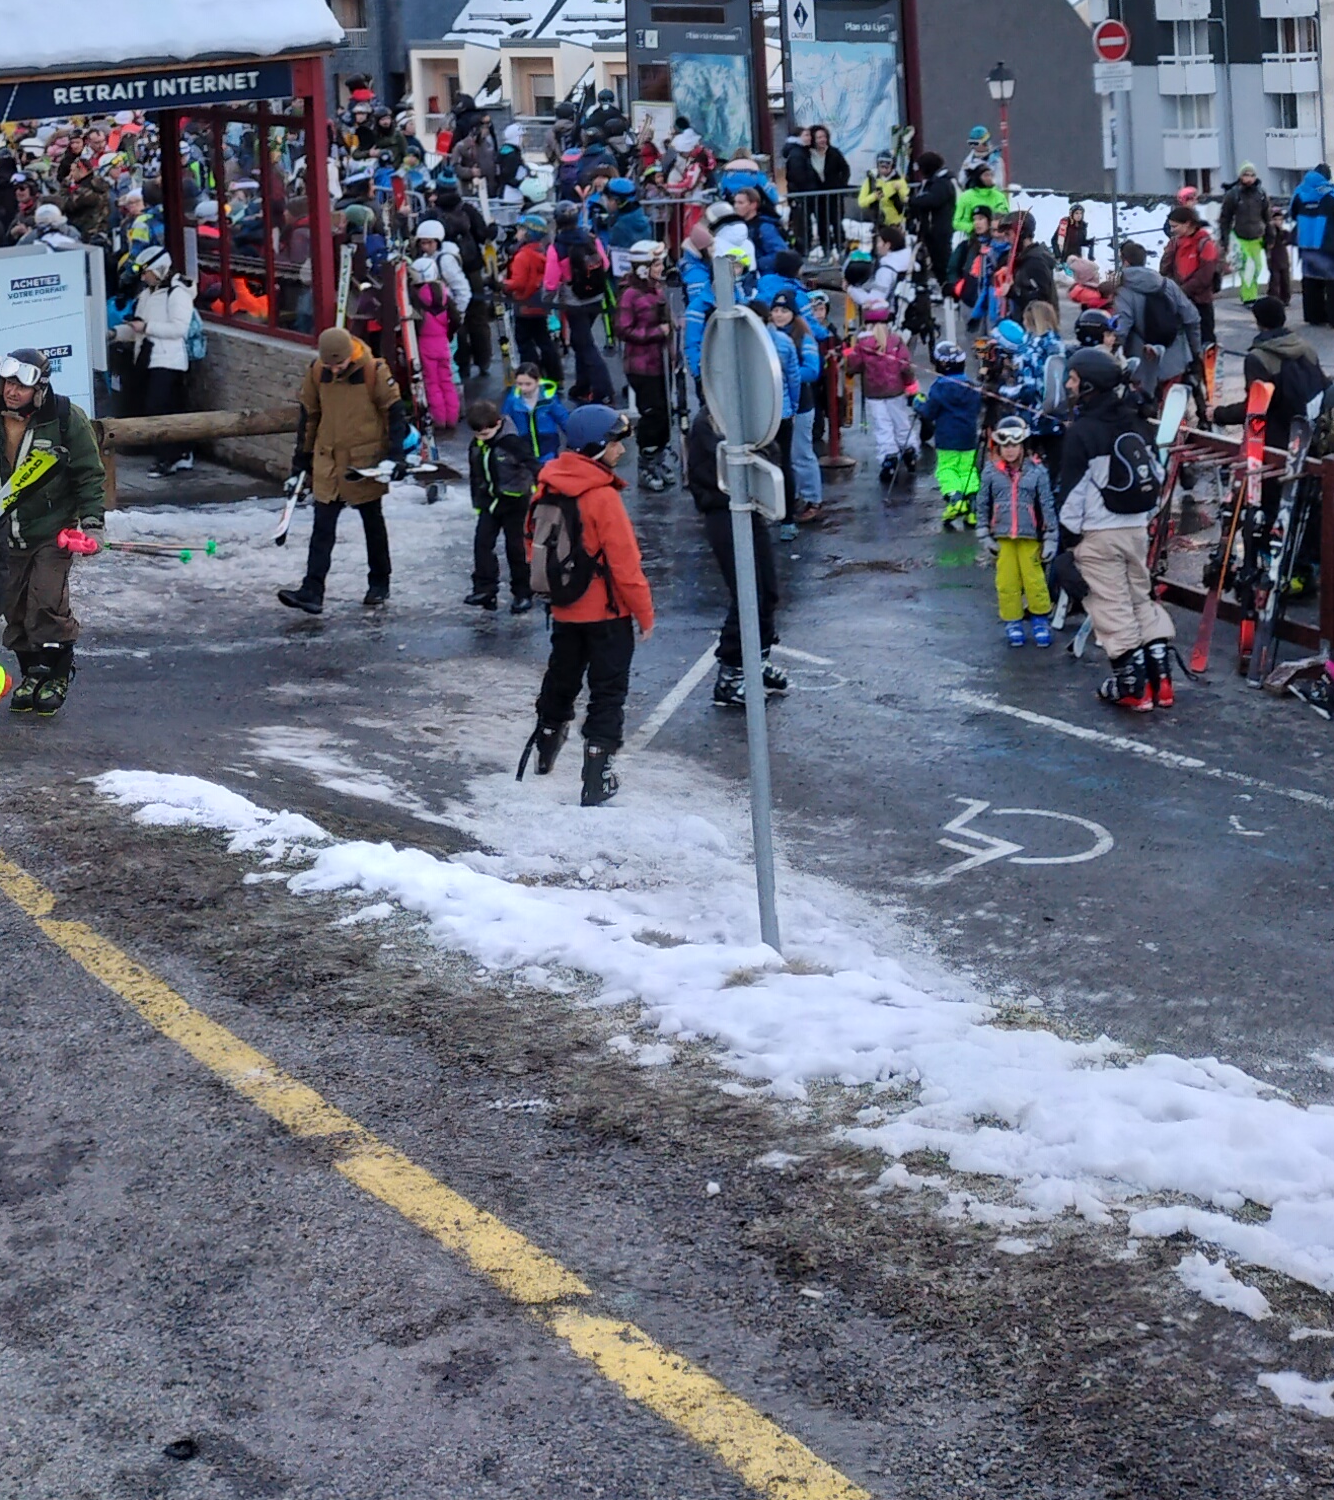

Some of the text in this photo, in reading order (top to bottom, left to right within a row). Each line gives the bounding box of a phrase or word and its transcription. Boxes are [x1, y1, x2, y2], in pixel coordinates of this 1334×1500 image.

[53, 71, 260, 105] RETRAIT INTERNET
[12, 276, 59, 290] ACHETEZ
[14, 458, 44, 488] HEAD
